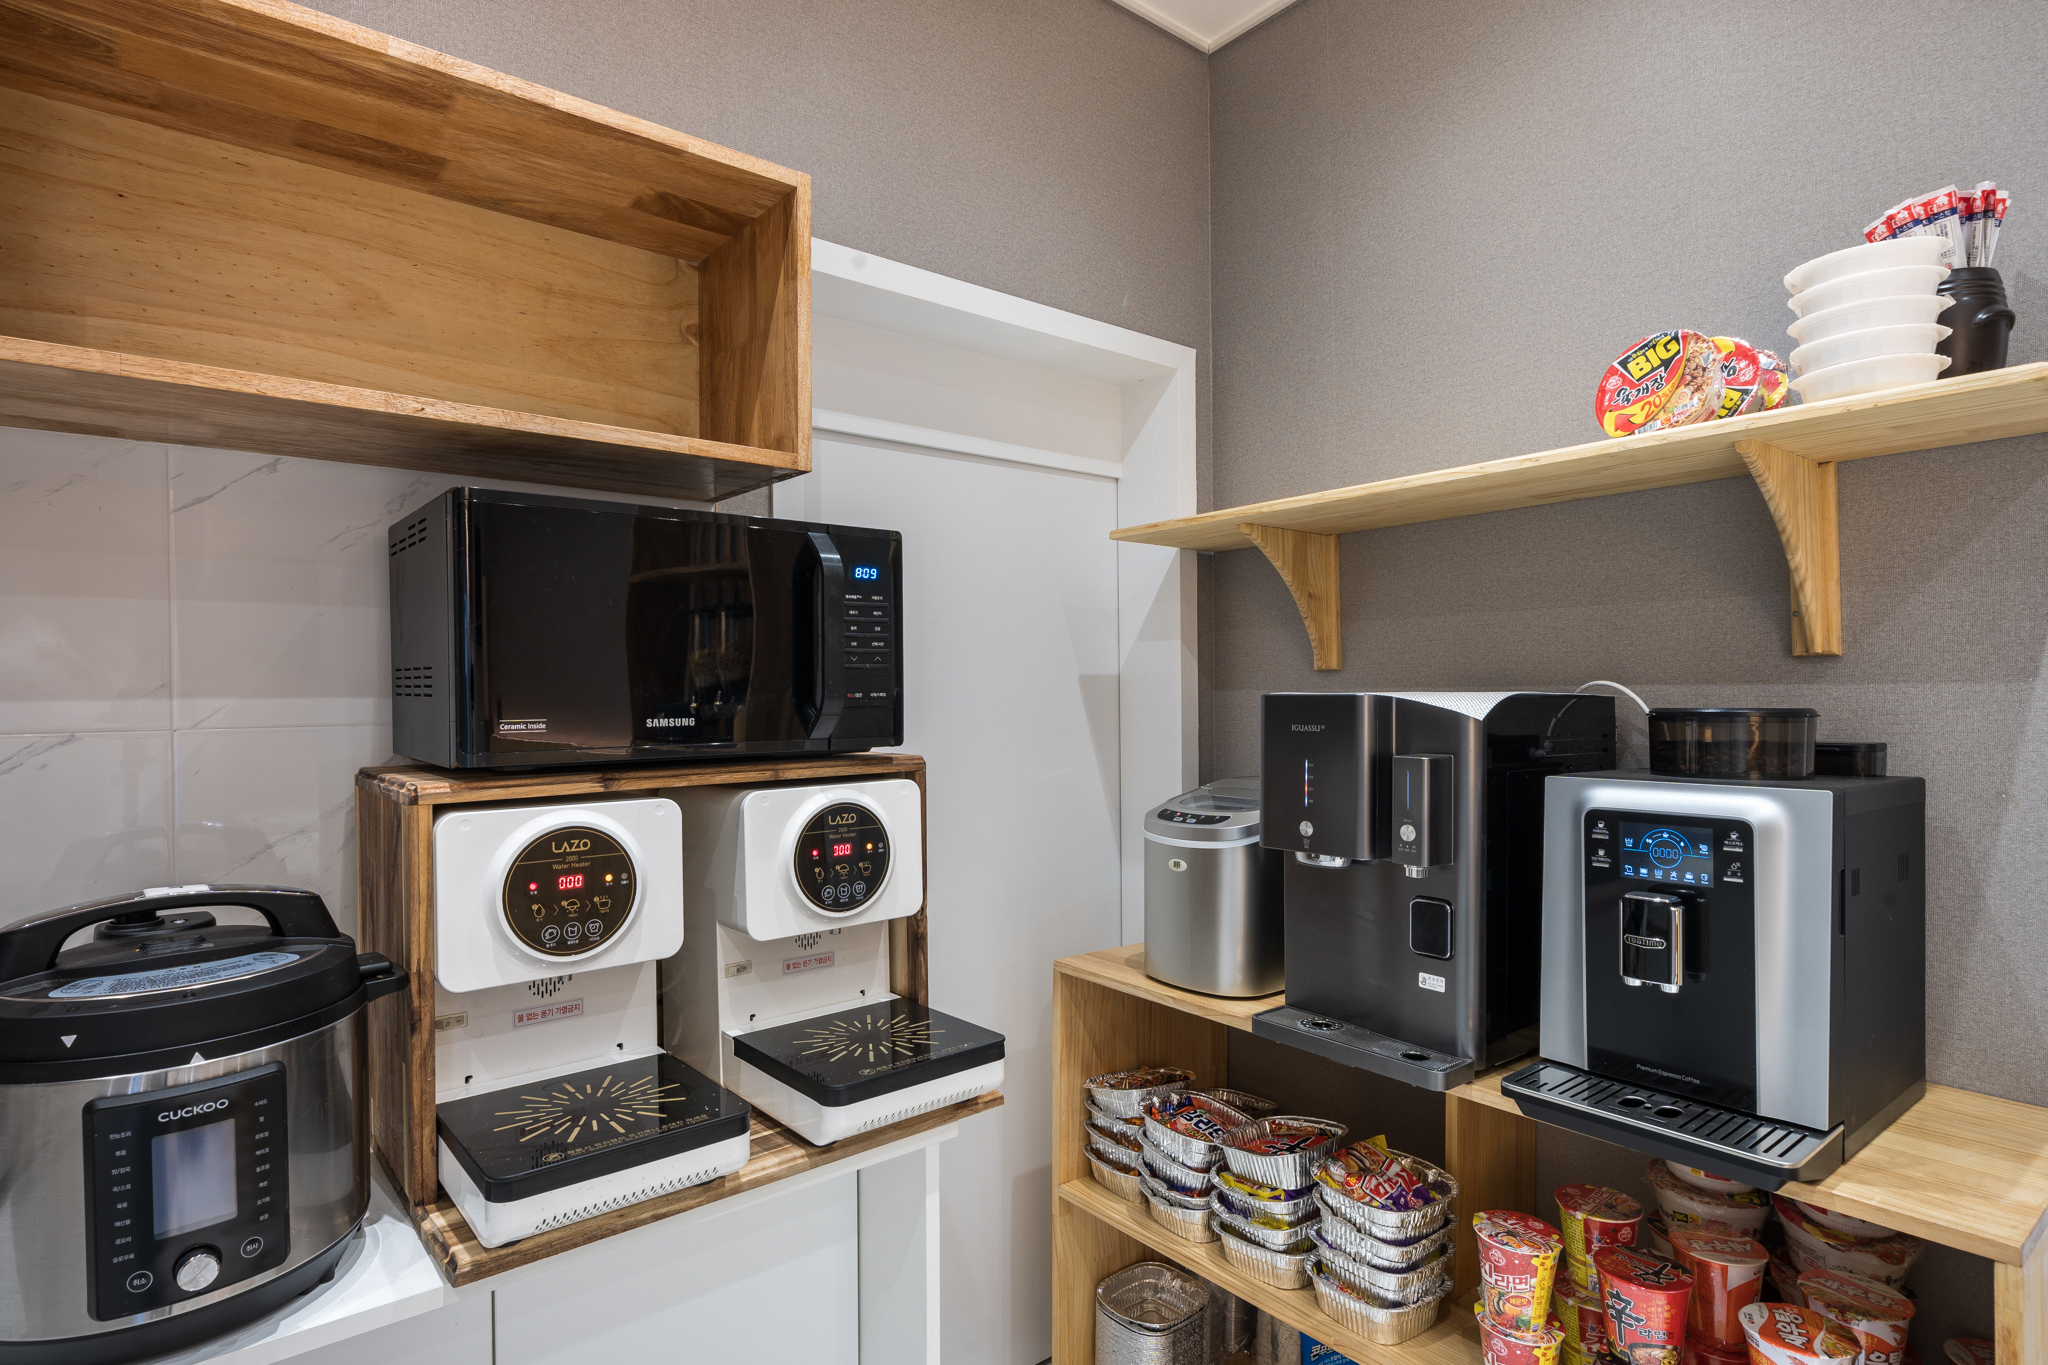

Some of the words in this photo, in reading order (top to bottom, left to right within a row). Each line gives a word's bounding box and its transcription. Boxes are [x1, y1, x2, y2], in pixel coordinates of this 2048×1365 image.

[1626, 335, 1680, 381] BIG
[1612, 373, 1666, 406] 육개장
[528, 722, 546, 730] Inside
[646, 717, 696, 728] SAMSUNG
[1291, 724, 1320, 732] IGUASSU
[828, 813, 857, 825] LAZO
[552, 838, 591, 853] LAZO
[517, 1013, 525, 1023] 물
[526, 1011, 539, 1021] 없는
[541, 1008, 554, 1018] 용기
[555, 1003, 580, 1015] 가열금지
[1636, 1063, 1658, 1075] Premium
[1658, 1069, 1681, 1080] Espresso
[1682, 1075, 1701, 1085] Coffee
[158, 1099, 229, 1122] CUCKOO
[246, 1242, 259, 1252] 취사
[132, 1277, 147, 1287] 취소
[1481, 1262, 1531, 1293] 진라면
[1509, 1297, 1528, 1306] 매운맛
[1605, 1288, 1647, 1346] 辛
[1638, 1328, 1668, 1340] 라면
[1771, 1307, 1809, 1350] 새우탕
